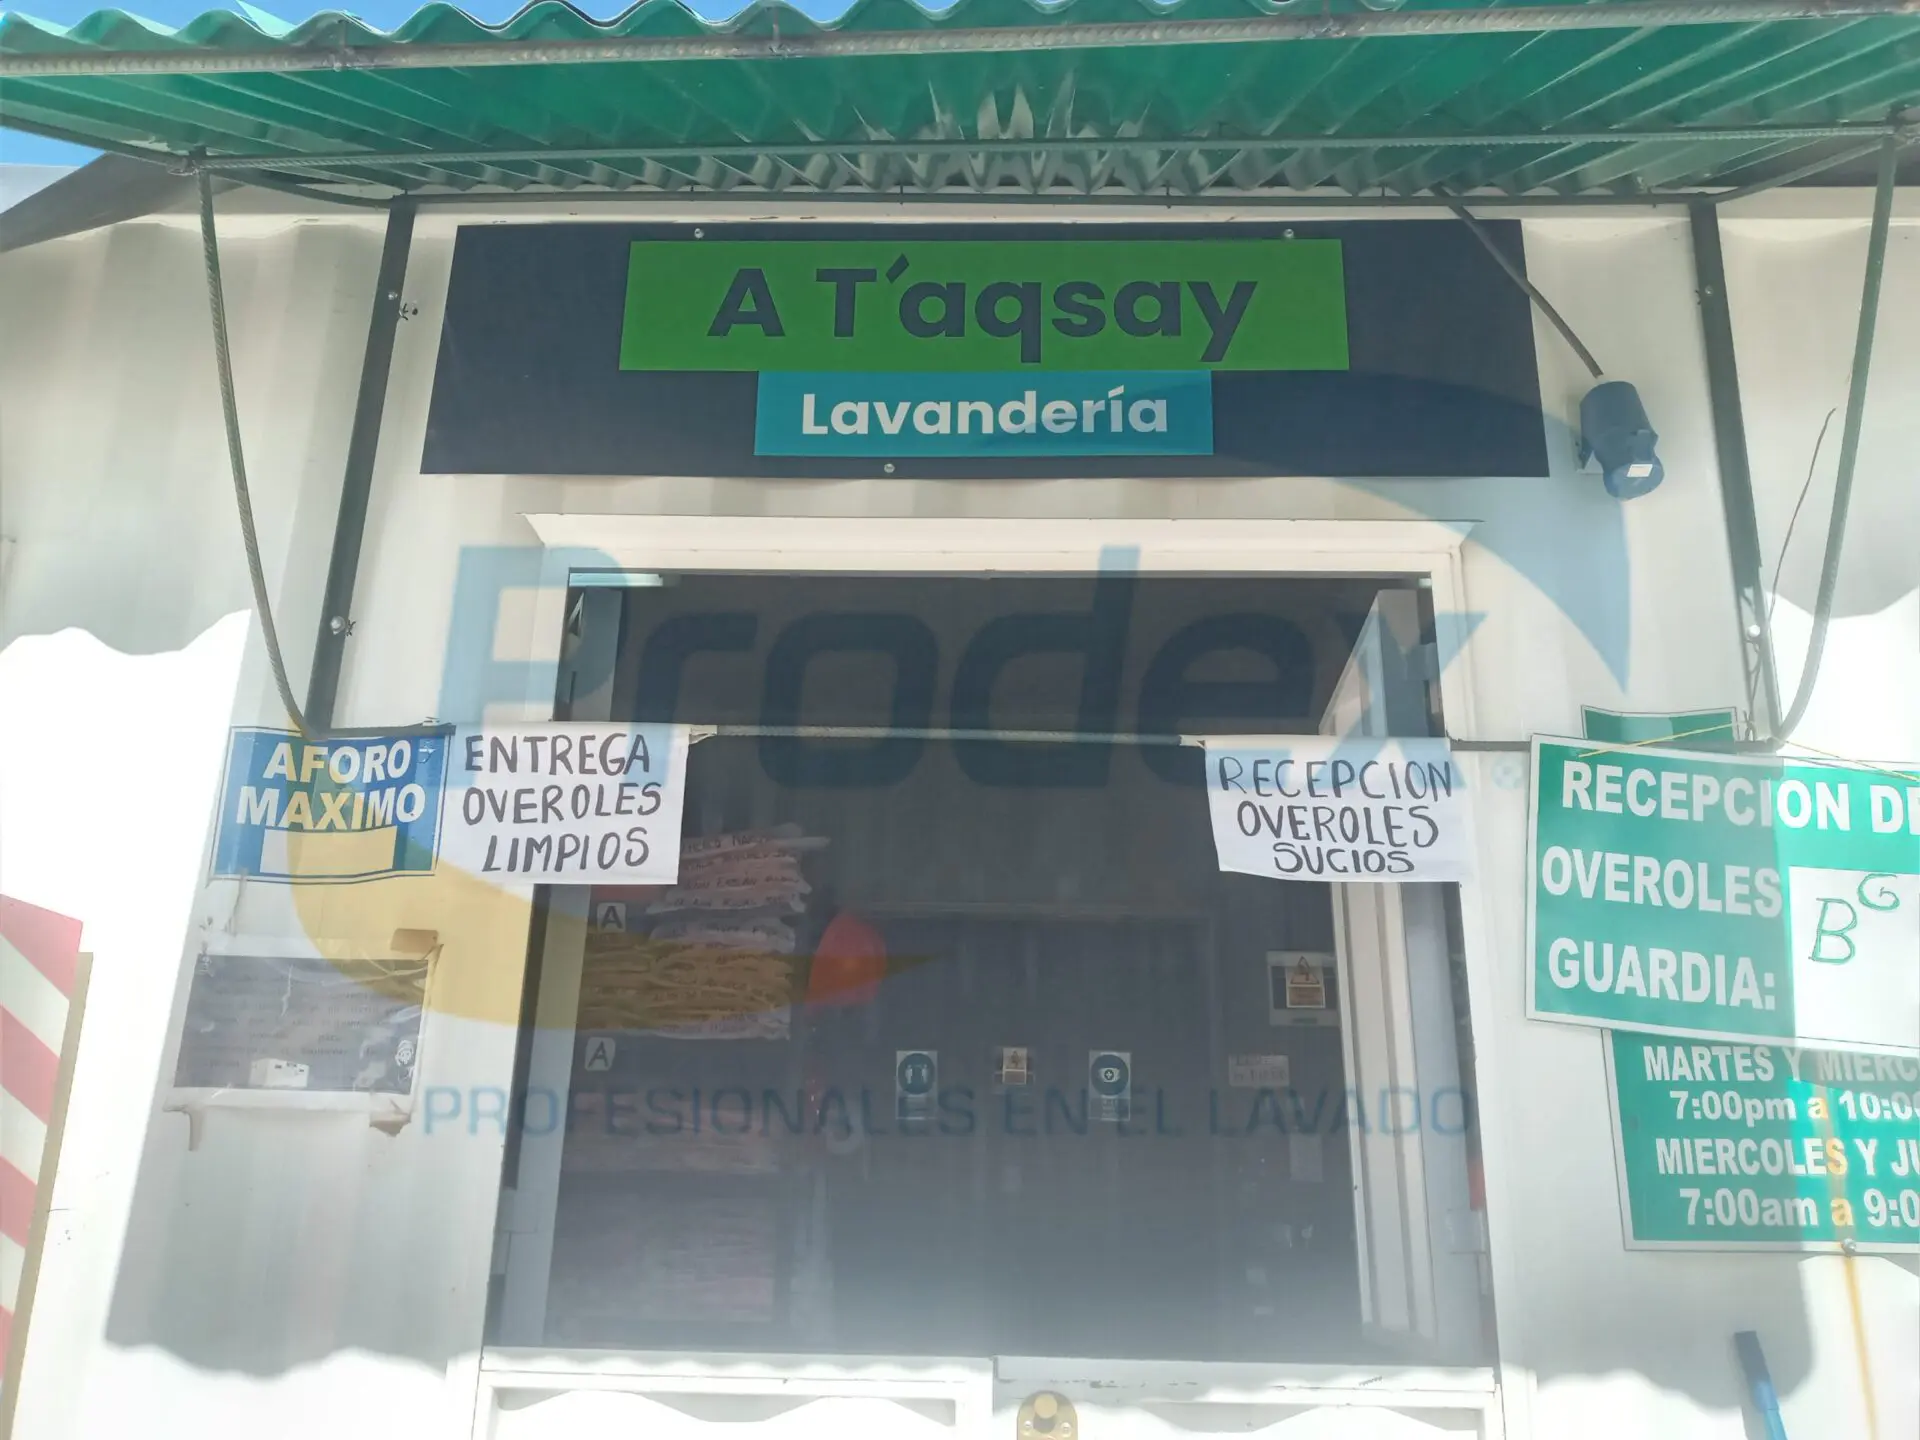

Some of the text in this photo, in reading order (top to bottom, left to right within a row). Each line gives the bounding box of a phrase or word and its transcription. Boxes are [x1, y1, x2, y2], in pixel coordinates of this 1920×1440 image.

[706, 267, 786, 338] A
[802, 385, 1168, 436] Lavandería
[263, 739, 412, 785] AFORO
[464, 733, 651, 777] ENTREGA
[1218, 756, 1452, 802] RECEPCION
[1561, 760, 1851, 832] RECEPCION
[236, 783, 426, 832] MAXIMO
[462, 782, 663, 825] OVEROLES
[1237, 800, 1440, 848] OVEROLES
[482, 826, 650, 873] LIMPIOS
[1272, 842, 1416, 875] SUCIOS
[1541, 846, 1783, 918] OVEROLES
[601, 904, 624, 930] A
[1548, 937, 1776, 1011] GUARDIA:
[587, 1039, 610, 1068] A
[1643, 1045, 1775, 1082] MARTES
[1781, 1046, 1803, 1082] Y
[1669, 1090, 1797, 1127] 7:00pm
[1807, 1096, 1829, 1121] a
[1655, 1137, 1849, 1176] MIERCOLES
[1854, 1138, 1878, 1176] Y
[1678, 1188, 1819, 1227] 7:00am
[1830, 1197, 1854, 1227] a
